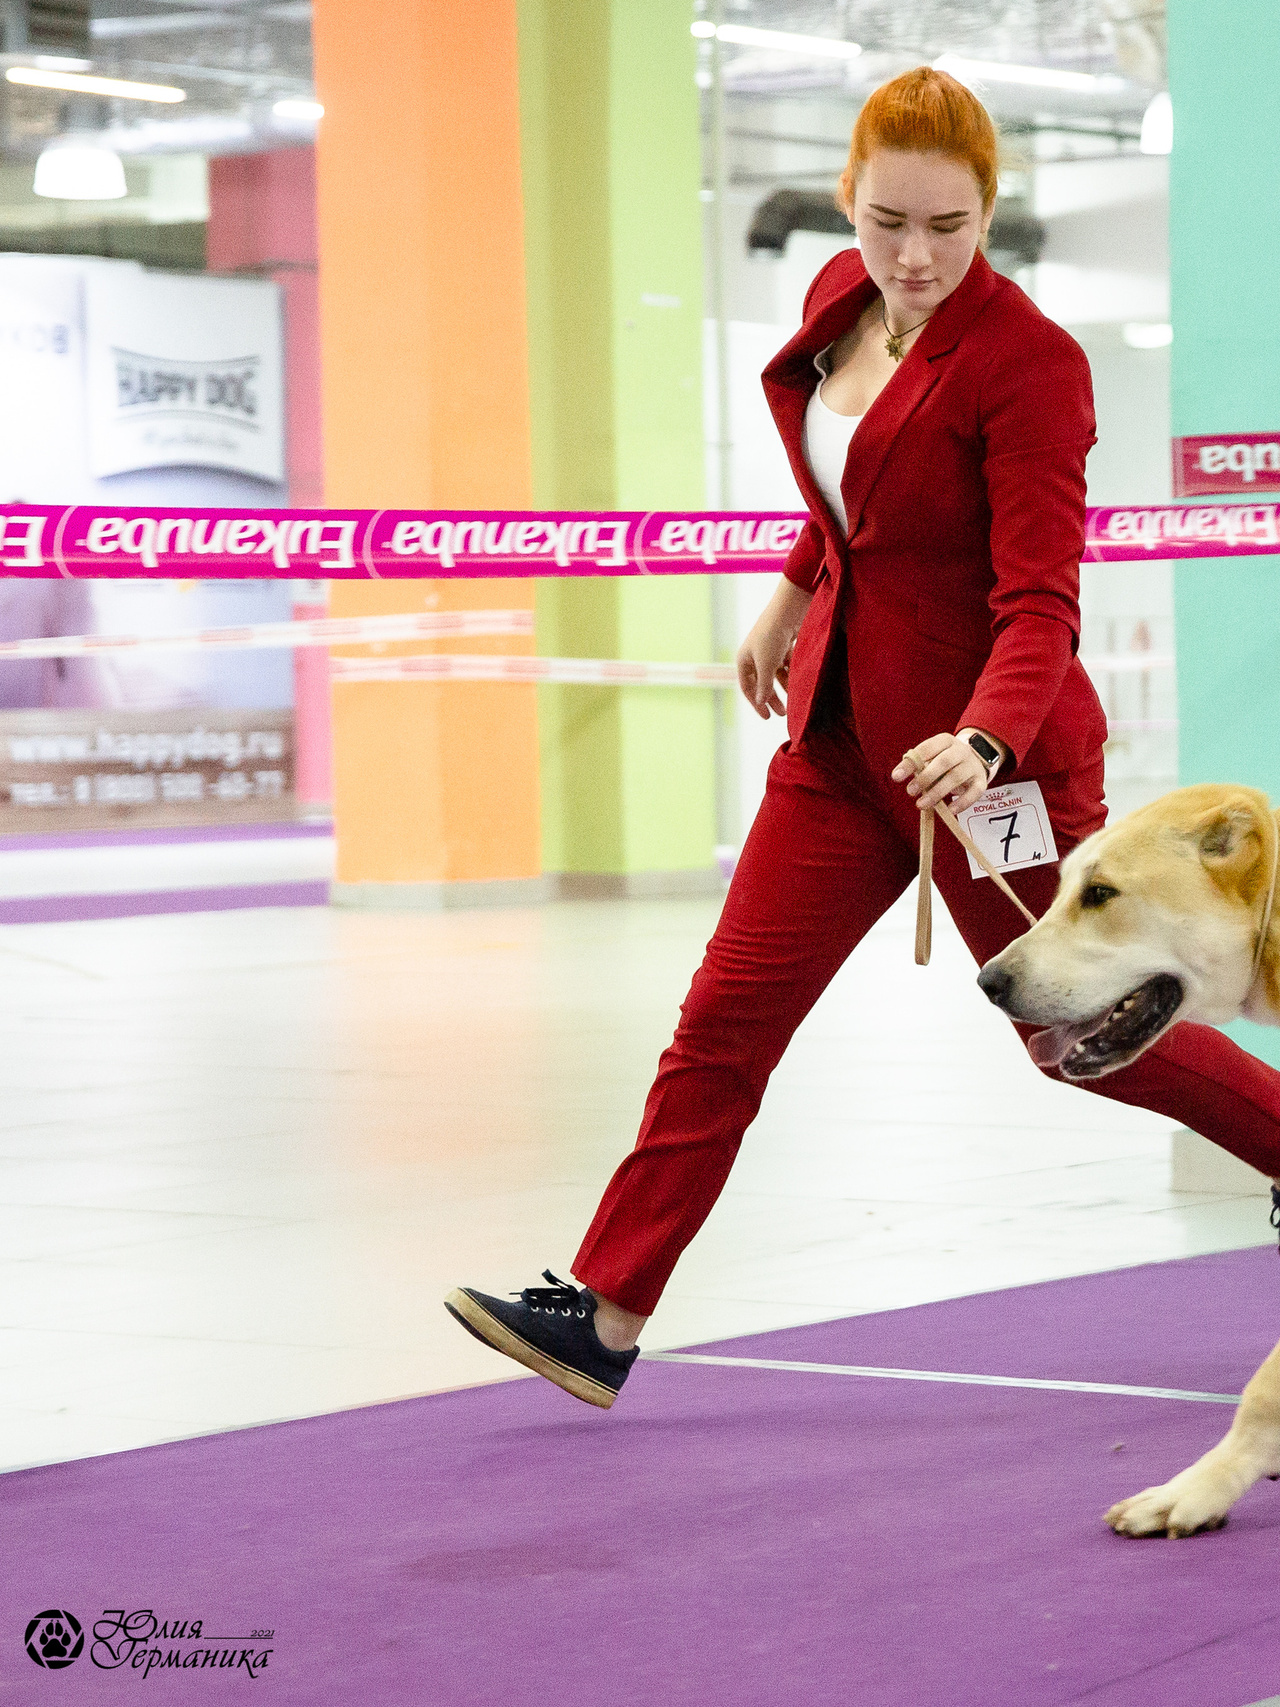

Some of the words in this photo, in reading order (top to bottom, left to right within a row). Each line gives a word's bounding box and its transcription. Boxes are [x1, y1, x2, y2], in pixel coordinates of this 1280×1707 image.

[116, 362, 197, 408] HAPPY
[204, 366, 258, 416] DOG
[86, 517, 358, 569] Eukanuba
[391, 519, 631, 568] Eukanuba
[659, 518, 807, 565] anuba
[1108, 504, 1278, 550] Eukanuba
[973, 805, 997, 813] ROYAL
[998, 797, 1023, 809] CANIN
[988, 810, 1021, 863] 7
